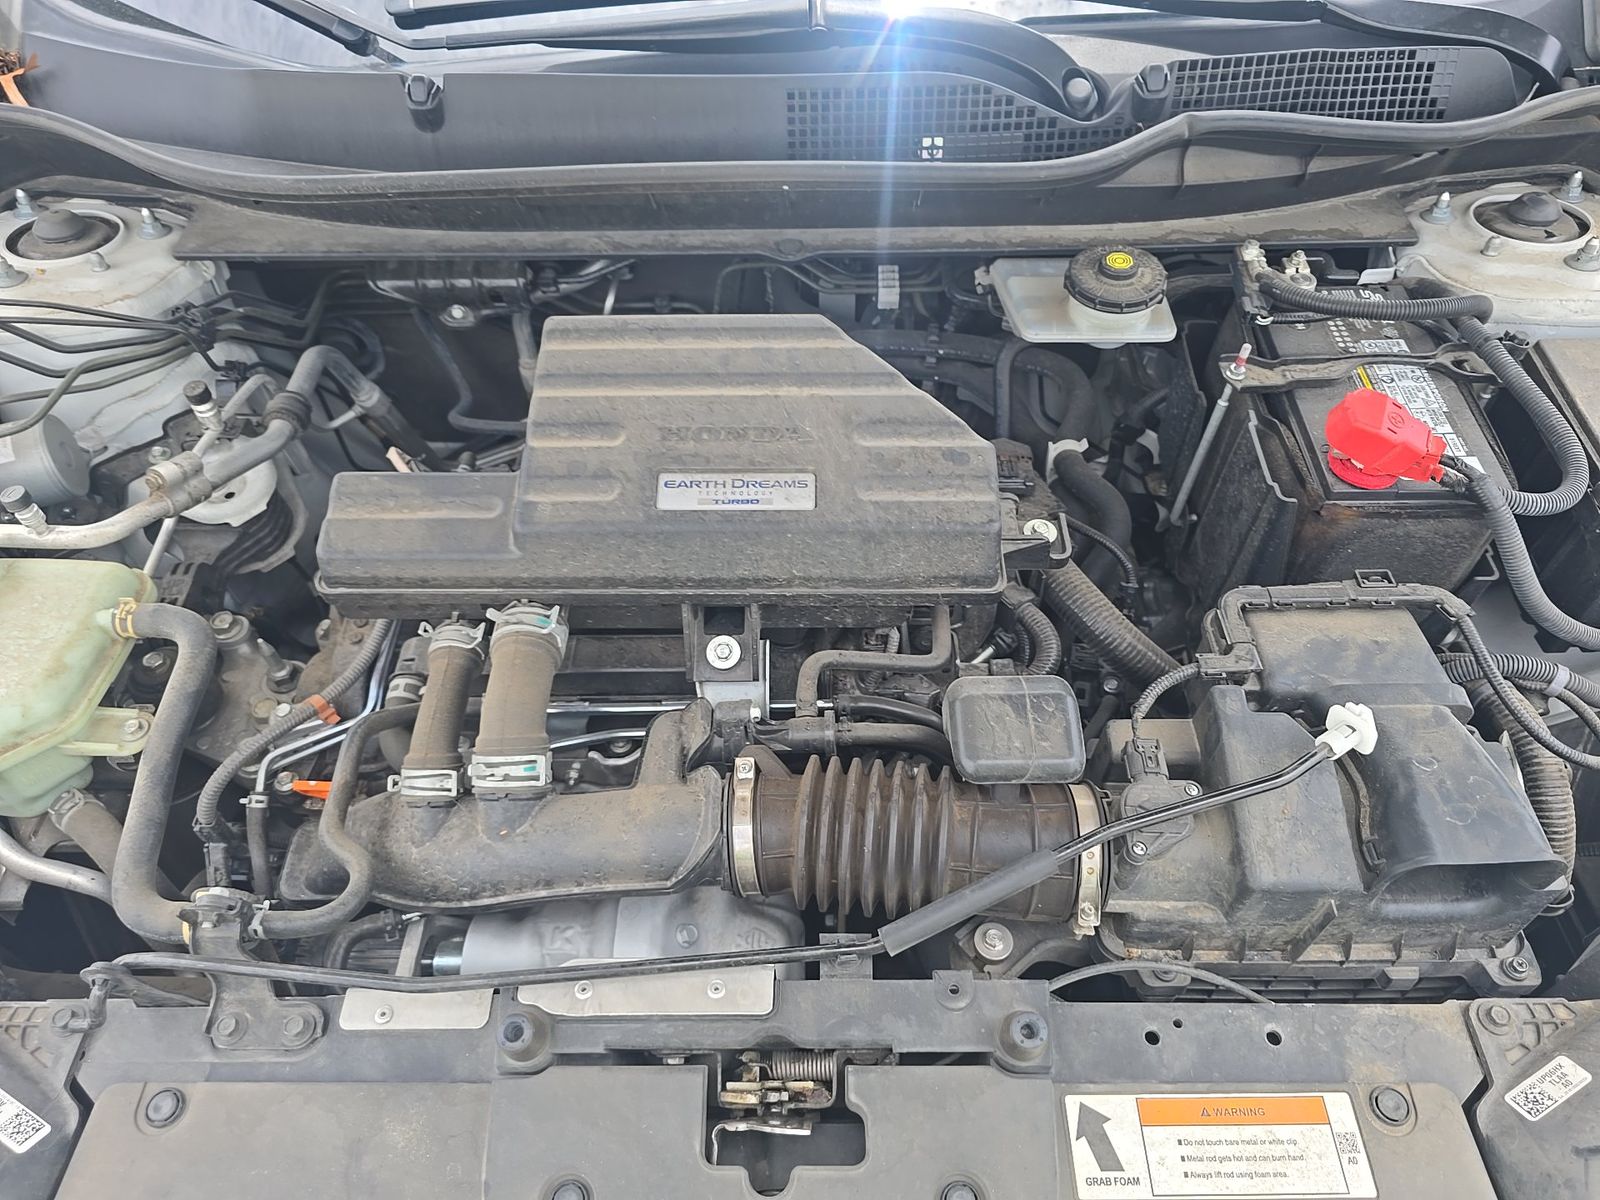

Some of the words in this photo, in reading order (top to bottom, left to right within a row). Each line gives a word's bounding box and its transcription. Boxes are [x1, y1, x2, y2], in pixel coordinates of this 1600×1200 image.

[657, 424, 816, 443] HONDA
[663, 479, 727, 489] EARTH
[731, 478, 809, 489] DREAMS
[1548, 1071, 1569, 1087] TLAA
[1213, 1107, 1266, 1117] WARNING
[1183, 1138, 1194, 1146] Do
[1206, 1138, 1224, 1146] touch
[1225, 1138, 1240, 1146] bare
[1241, 1138, 1258, 1146] metal
[1268, 1138, 1285, 1146] white
[1187, 1154, 1205, 1162] Metal
[1218, 1155, 1232, 1164] gets
[1233, 1154, 1244, 1162] hot
[1245, 1154, 1257, 1162] and
[1271, 1154, 1287, 1162] burn
[1190, 1171, 1213, 1180] Always
[1236, 1171, 1254, 1180] using
[1254, 1170, 1271, 1178] foam
[1085, 1177, 1112, 1186] GRAB
[1114, 1176, 1141, 1186] FOAM
